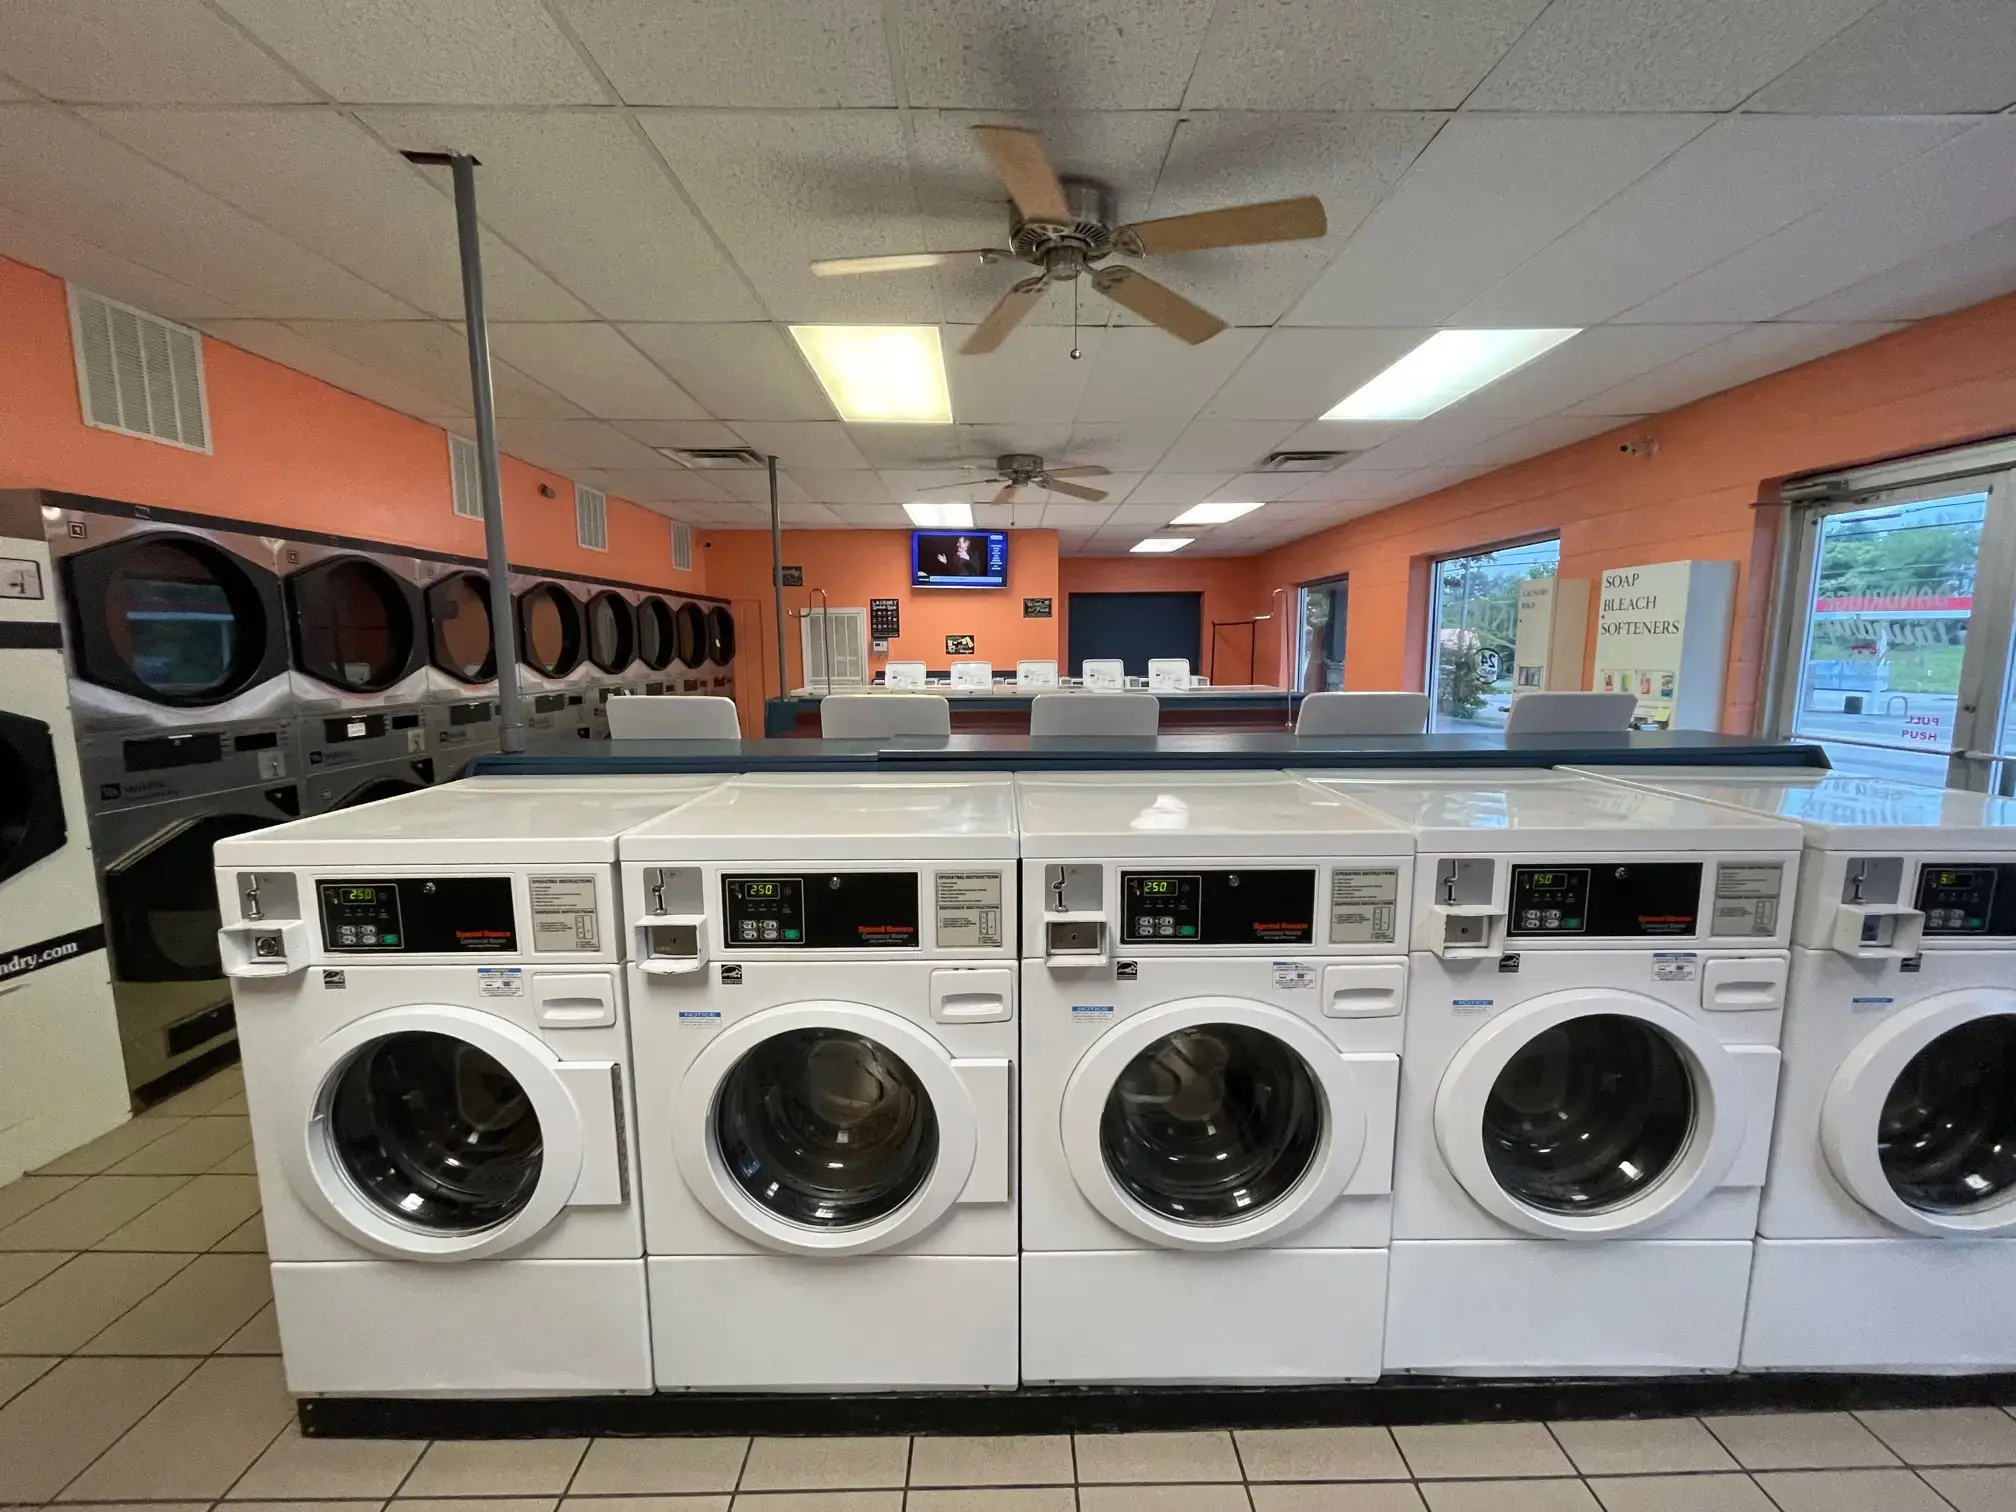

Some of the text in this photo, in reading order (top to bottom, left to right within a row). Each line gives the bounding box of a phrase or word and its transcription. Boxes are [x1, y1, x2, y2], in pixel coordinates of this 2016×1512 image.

[1604, 572, 1640, 588] SOAP
[1603, 595, 1657, 612] BLEACH
[1600, 619, 1680, 636] SOFTENERS
[1901, 729, 1938, 742] PUSH
[750, 884, 773, 895] 250
[1144, 881, 1167, 892] 250
[349, 888, 372, 900] 250
